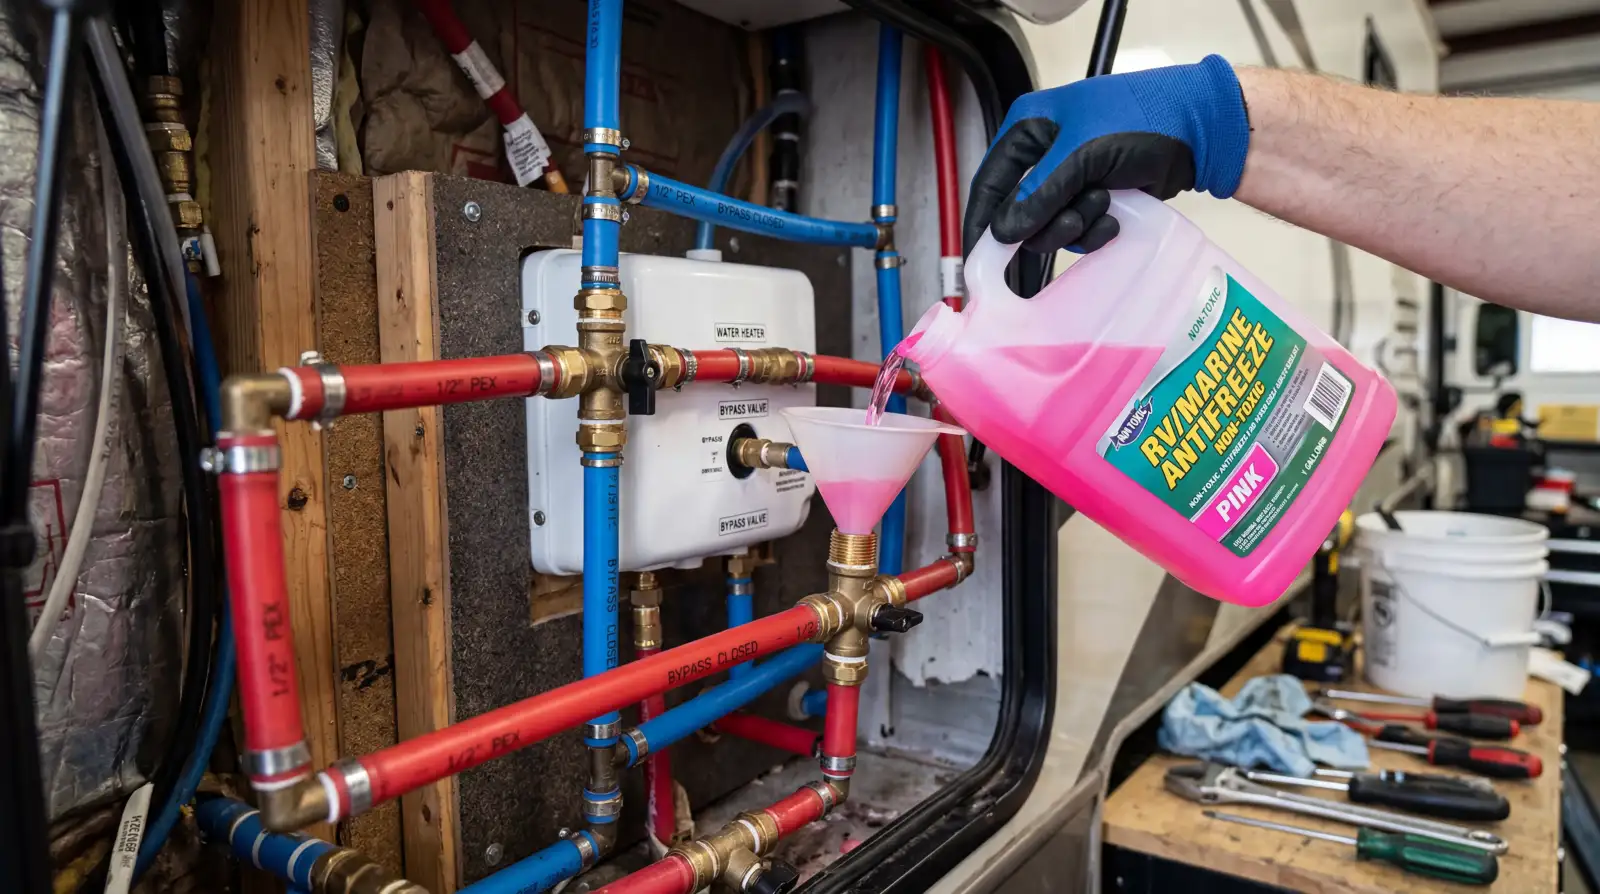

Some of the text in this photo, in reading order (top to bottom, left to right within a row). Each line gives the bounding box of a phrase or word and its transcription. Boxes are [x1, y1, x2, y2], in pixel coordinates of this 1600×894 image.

[655, 184, 785, 229] 1/2" PEX BYPASS CLOSED
[717, 327, 765, 338] WATER HEATER
[1188, 287, 1221, 341] NON-TOXIC
[437, 376, 498, 395] 1/2" PEX
[1140, 306, 1253, 468] RV/MARINE
[1161, 321, 1275, 490] ANTIFREEZE
[720, 402, 767, 416] BYPASS VALVE
[1127, 405, 1148, 430] TOXIC
[1213, 380, 1266, 456] NON-TOXIC
[1188, 472, 1220, 508] NON-TOXIC
[1215, 462, 1264, 522] PINK
[720, 513, 767, 532] BYPASS VALVE
[262, 602, 284, 641] PEX
[606, 558, 617, 671] BYPASS CLOSE
[667, 657, 712, 685] BYPASS
[717, 640, 759, 666] CLOSED
[491, 729, 521, 753] PEX
